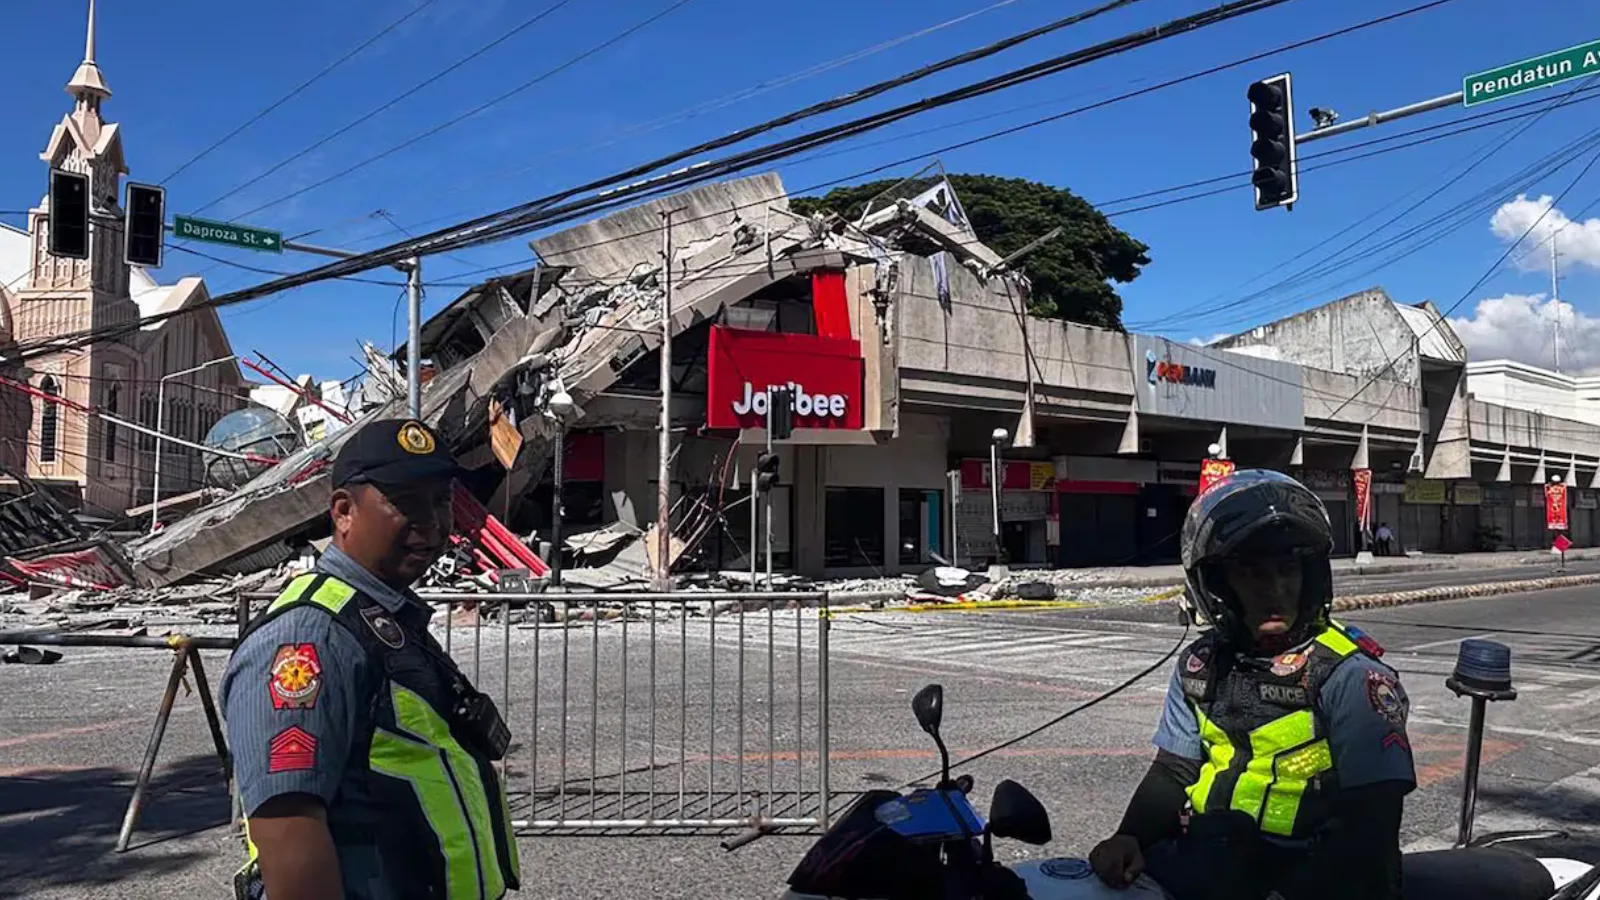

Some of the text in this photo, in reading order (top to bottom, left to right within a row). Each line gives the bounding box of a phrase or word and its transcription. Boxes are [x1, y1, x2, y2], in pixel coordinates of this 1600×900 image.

[1471, 59, 1571, 97] Pendatun
[183, 222, 259, 244] Daproza St.
[733, 381, 846, 417] Joibee
[1260, 683, 1305, 701] POLICE
